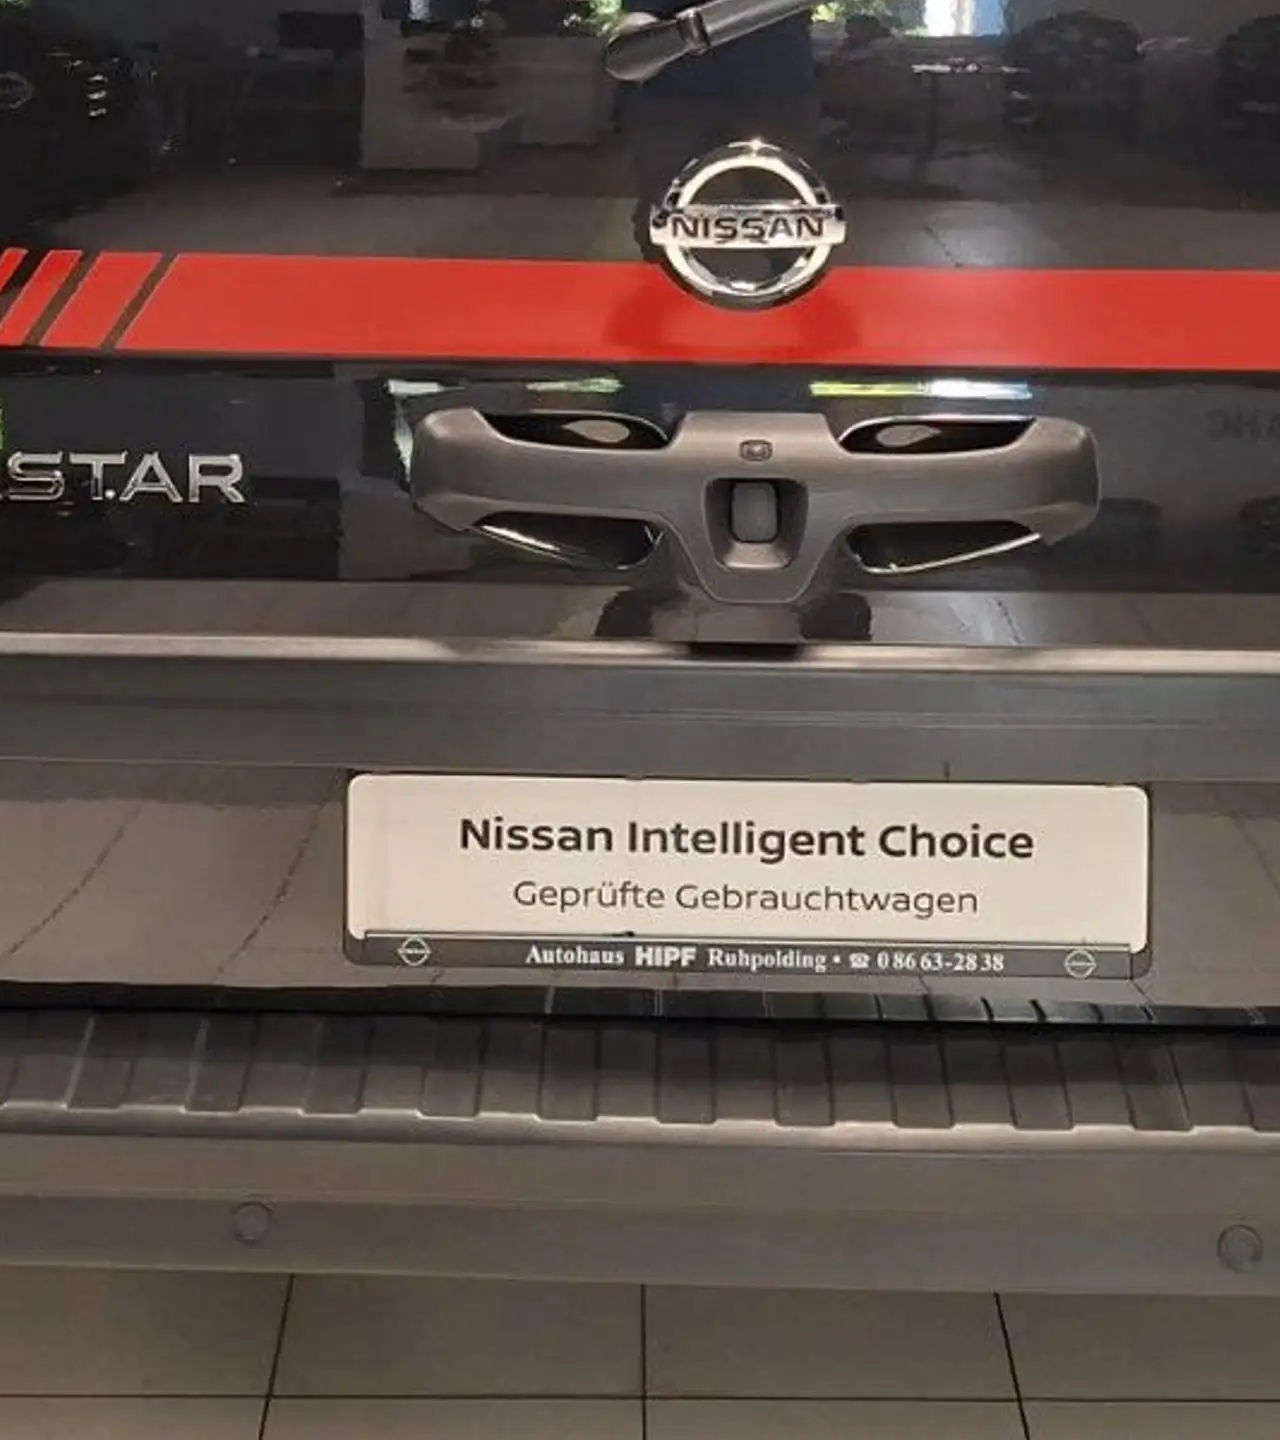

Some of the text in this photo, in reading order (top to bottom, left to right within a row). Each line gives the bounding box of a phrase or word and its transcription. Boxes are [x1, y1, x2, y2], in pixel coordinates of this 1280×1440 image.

[671, 214, 825, 245] NISSAN
[460, 816, 1034, 864] Nissan Intelligent Choice
[514, 880, 978, 919] Geprüfte Gebrauchtwagen
[526, 945, 624, 964] Autohaus
[635, 945, 697, 967] HIPF
[707, 947, 827, 973] Ruhpolding
